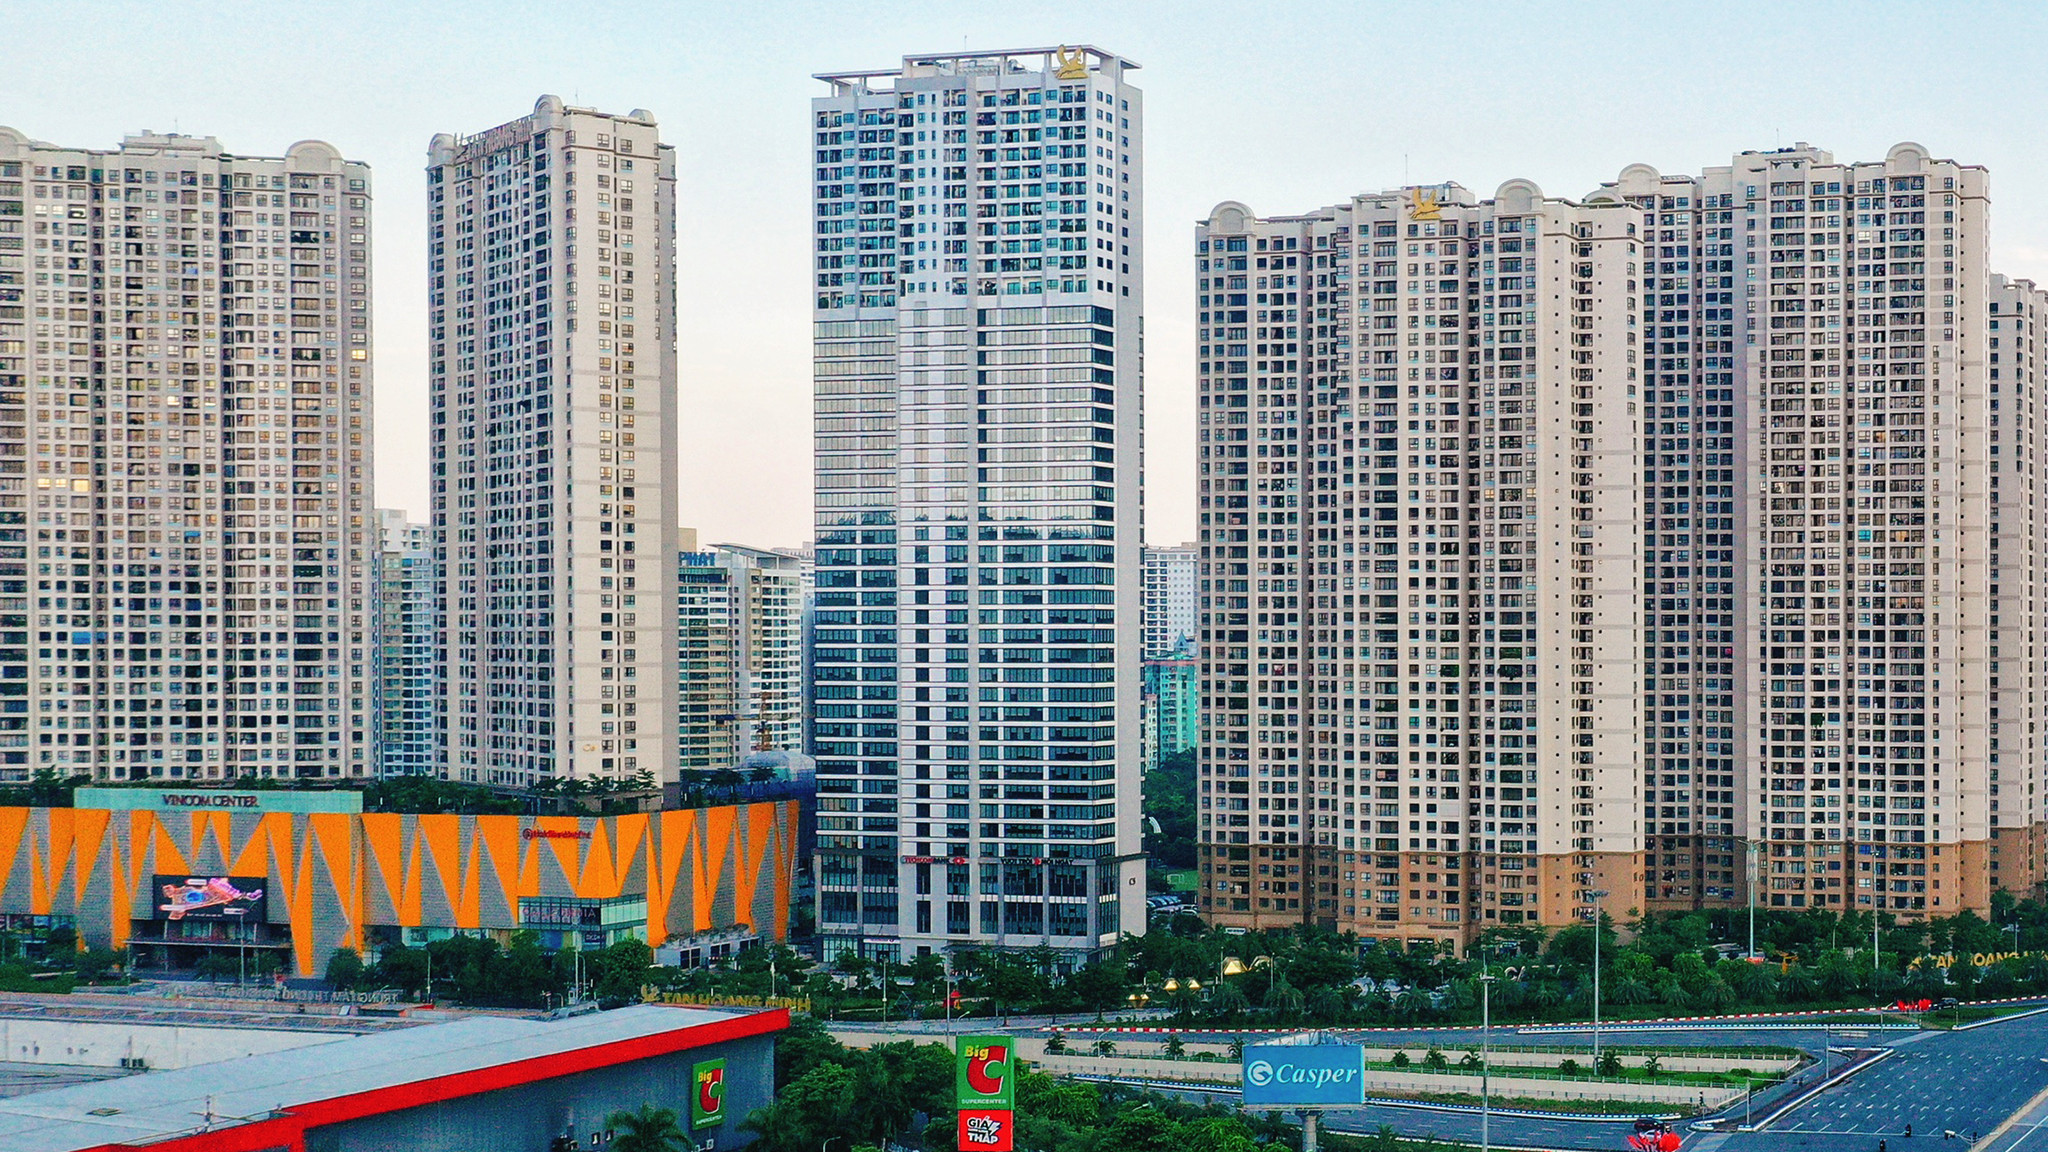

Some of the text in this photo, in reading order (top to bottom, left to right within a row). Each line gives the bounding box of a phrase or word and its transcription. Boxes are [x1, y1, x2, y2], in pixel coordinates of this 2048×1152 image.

[162, 794, 259, 807] VINCOM CENTER
[965, 1045, 989, 1061] Big
[967, 1046, 1007, 1095] C
[1276, 1063, 1358, 1089] Casper
[698, 1069, 723, 1114] Big C
[968, 1115, 990, 1130] GIÁ
